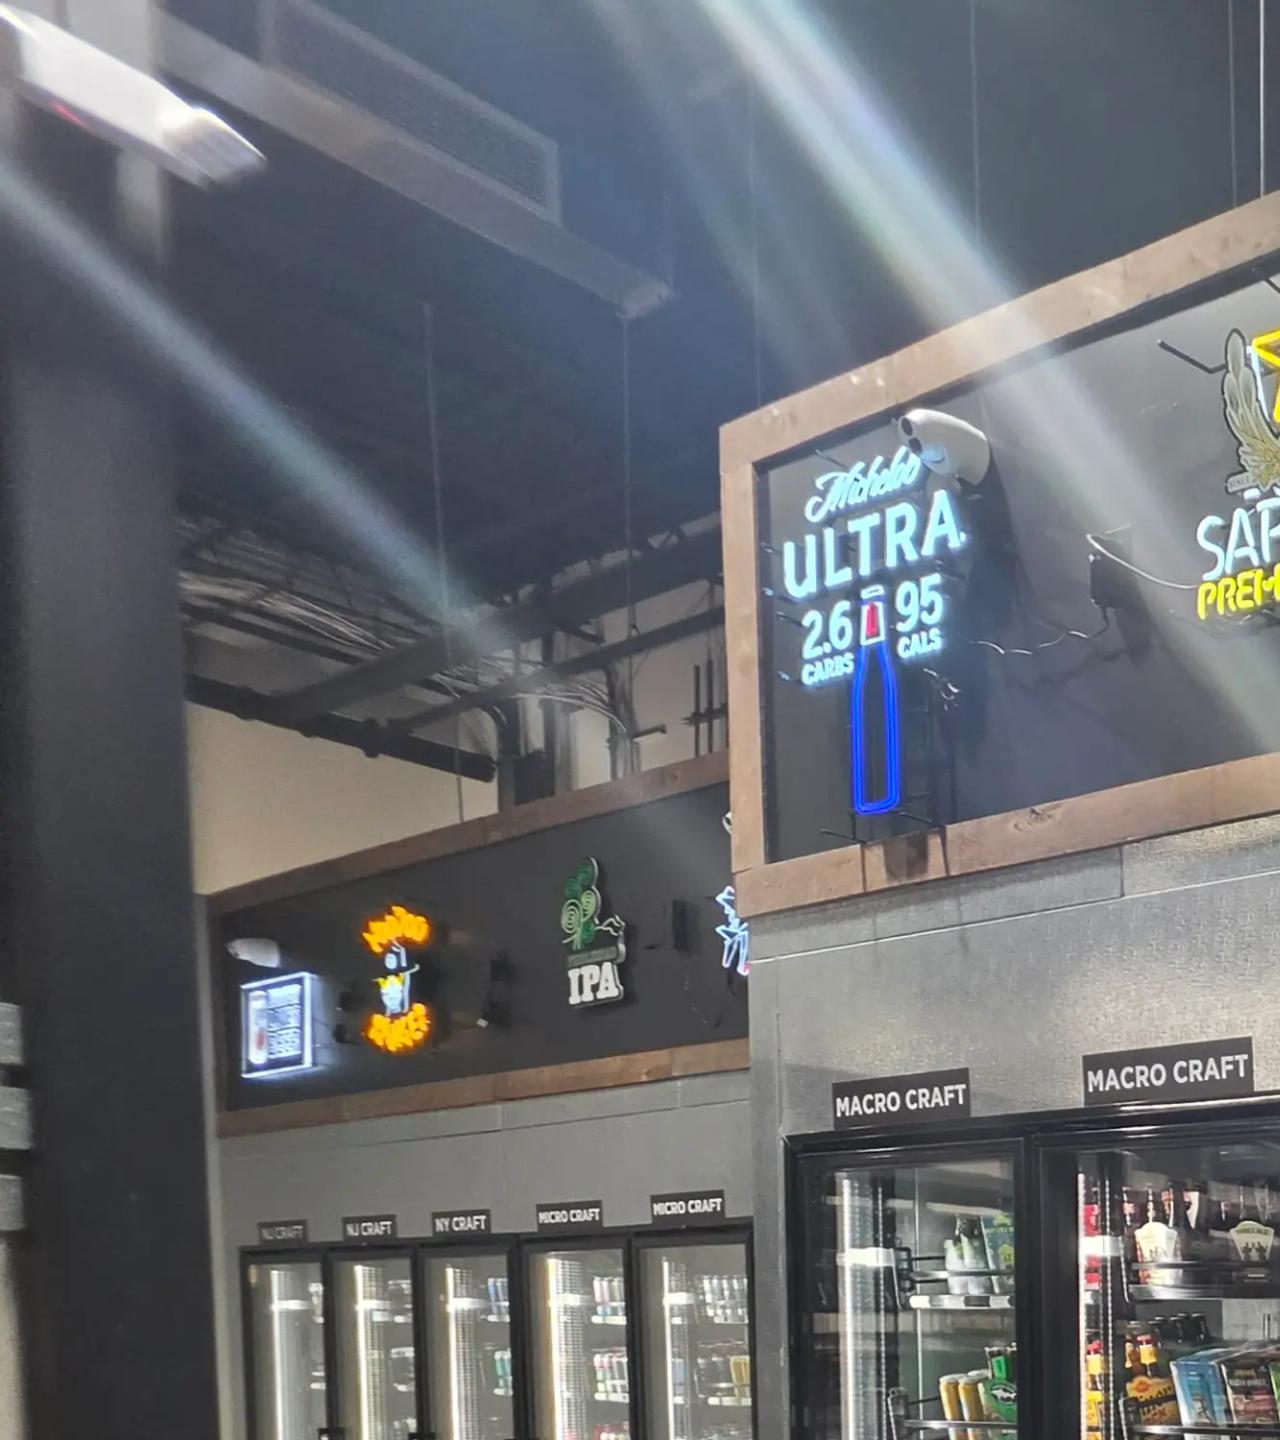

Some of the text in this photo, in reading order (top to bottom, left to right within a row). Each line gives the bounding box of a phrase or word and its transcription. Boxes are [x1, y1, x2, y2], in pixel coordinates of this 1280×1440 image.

[895, 572, 944, 633] 95
[801, 599, 853, 659] 2.6
[897, 629, 943, 660] CALS
[801, 652, 855, 686] CARBS
[568, 961, 620, 1005] IPA
[1087, 1053, 1249, 1094] MACRO CRAFT
[835, 1083, 967, 1118] MACRO CRAFT
[435, 1215, 486, 1232] NY CRAFT
[538, 1206, 600, 1224] MICRO CRAFT
[653, 1197, 723, 1216] MICRO CRAFT
[358, 1220, 392, 1236] CRAFT
